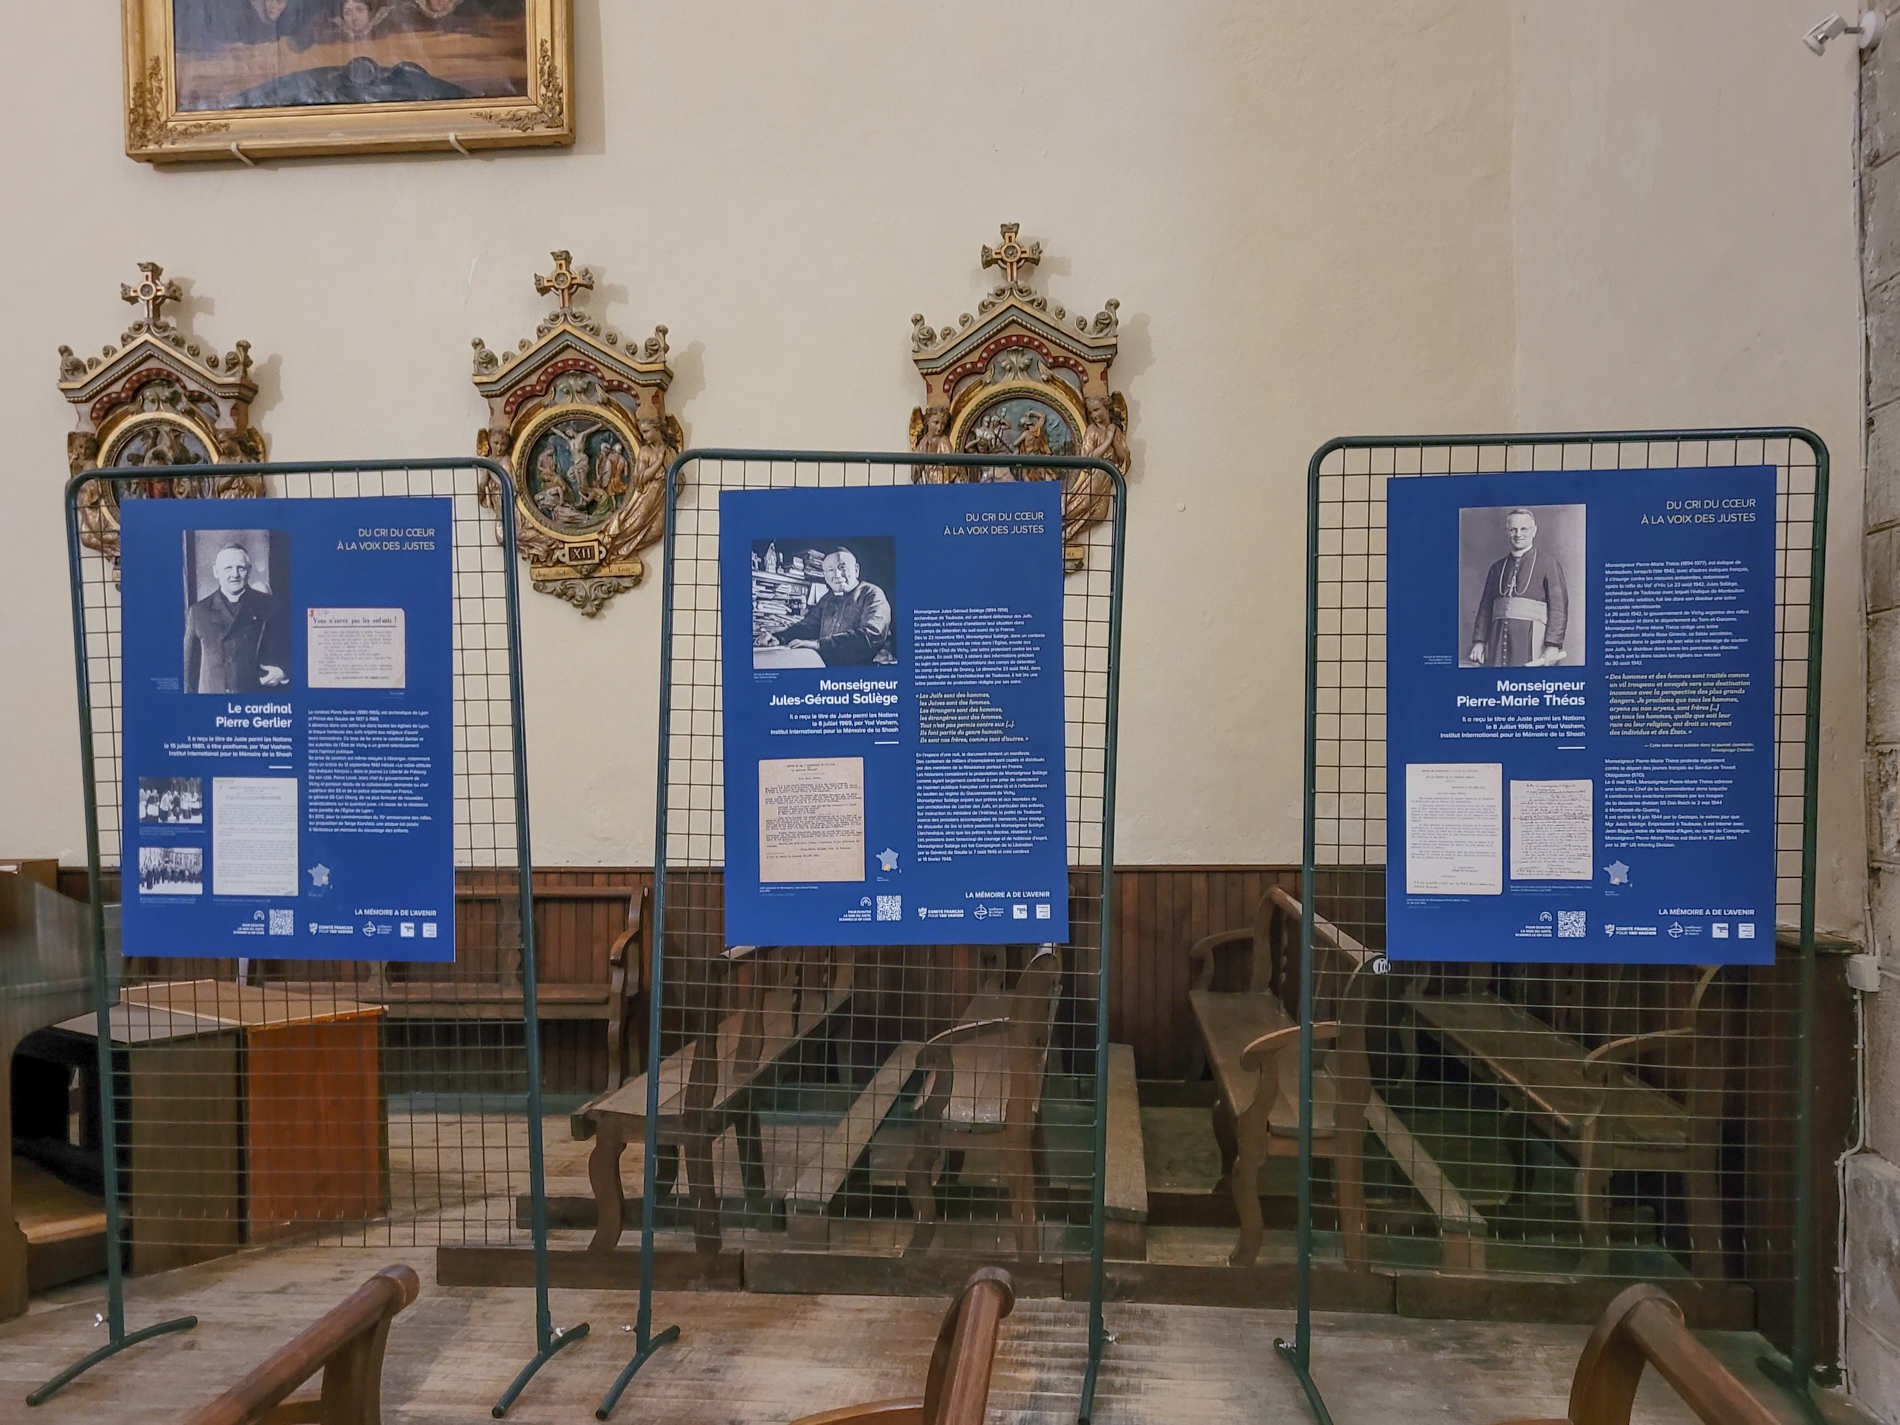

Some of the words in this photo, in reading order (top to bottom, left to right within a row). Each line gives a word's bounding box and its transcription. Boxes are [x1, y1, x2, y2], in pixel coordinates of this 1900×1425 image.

[1666, 500, 1682, 510] DU
[1684, 500, 1701, 510] CRI
[1704, 499, 1719, 509] DU
[1721, 498, 1756, 508] CŒUR
[966, 513, 980, 522] DU
[981, 512, 996, 522] CRI
[998, 512, 1012, 521] DU
[1014, 512, 1044, 521] CŒUR
[1641, 514, 1649, 524] À
[1651, 515, 1665, 524] LA
[1667, 514, 1692, 524] VOIX
[1694, 514, 1715, 523] DES
[1717, 512, 1756, 523] JUSTES
[358, 528, 372, 537] DU
[373, 528, 388, 537] CRI
[390, 528, 404, 537] DU
[405, 528, 435, 537] CŒUR
[944, 525, 951, 535] À
[952, 526, 965, 535] LA
[966, 526, 989, 535] VOIX
[990, 525, 1009, 534] DES
[1010, 524, 1044, 534] JUSTES
[337, 540, 344, 550] À
[345, 542, 357, 550] LA
[359, 541, 381, 550] VOIX
[382, 541, 400, 550] DES
[402, 541, 435, 550] JUSTES
[572, 548, 591, 559] XII
[820, 679, 898, 692] Monseigneur
[1497, 679, 1586, 694] Monseigneur
[769, 693, 849, 706] Jules-Géraud
[853, 692, 898, 706] Saliège
[1457, 695, 1540, 707] Pierre-Marie
[1543, 694, 1586, 706] Théas
[228, 702, 242, 714] Le
[244, 703, 292, 714] cardinal
[215, 716, 250, 728] Pierre
[252, 716, 292, 728] Gerlier
